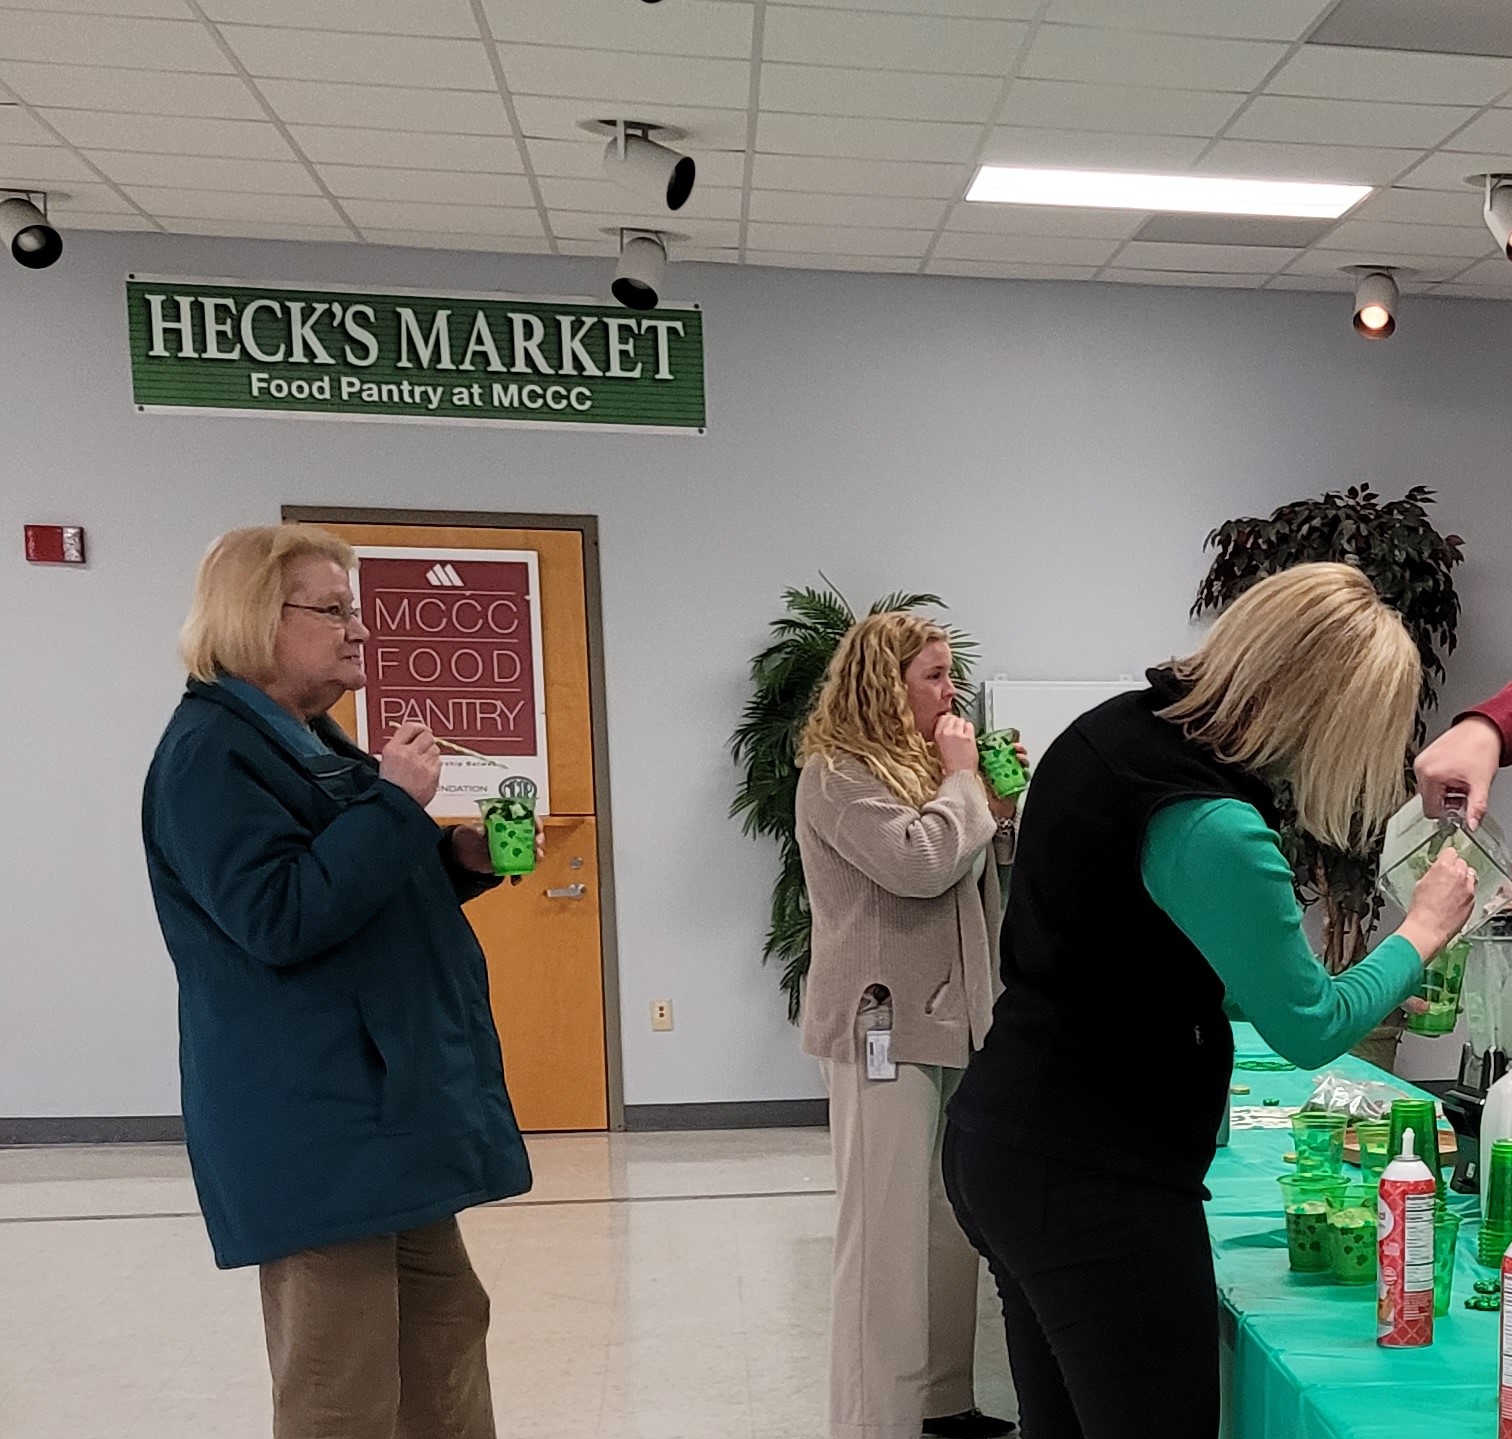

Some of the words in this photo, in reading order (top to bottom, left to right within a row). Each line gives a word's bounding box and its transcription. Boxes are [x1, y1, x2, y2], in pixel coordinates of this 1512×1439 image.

[144, 293, 379, 367] HECK'S
[395, 306, 685, 380] MARKET
[250, 372, 331, 399] Food
[340, 376, 443, 410] Pantry
[452, 383, 483, 406] at
[492, 383, 593, 411] MCCC
[375, 597, 519, 634] MCCC
[377, 647, 522, 683] FOOD
[380, 697, 525, 732] PANTRY
